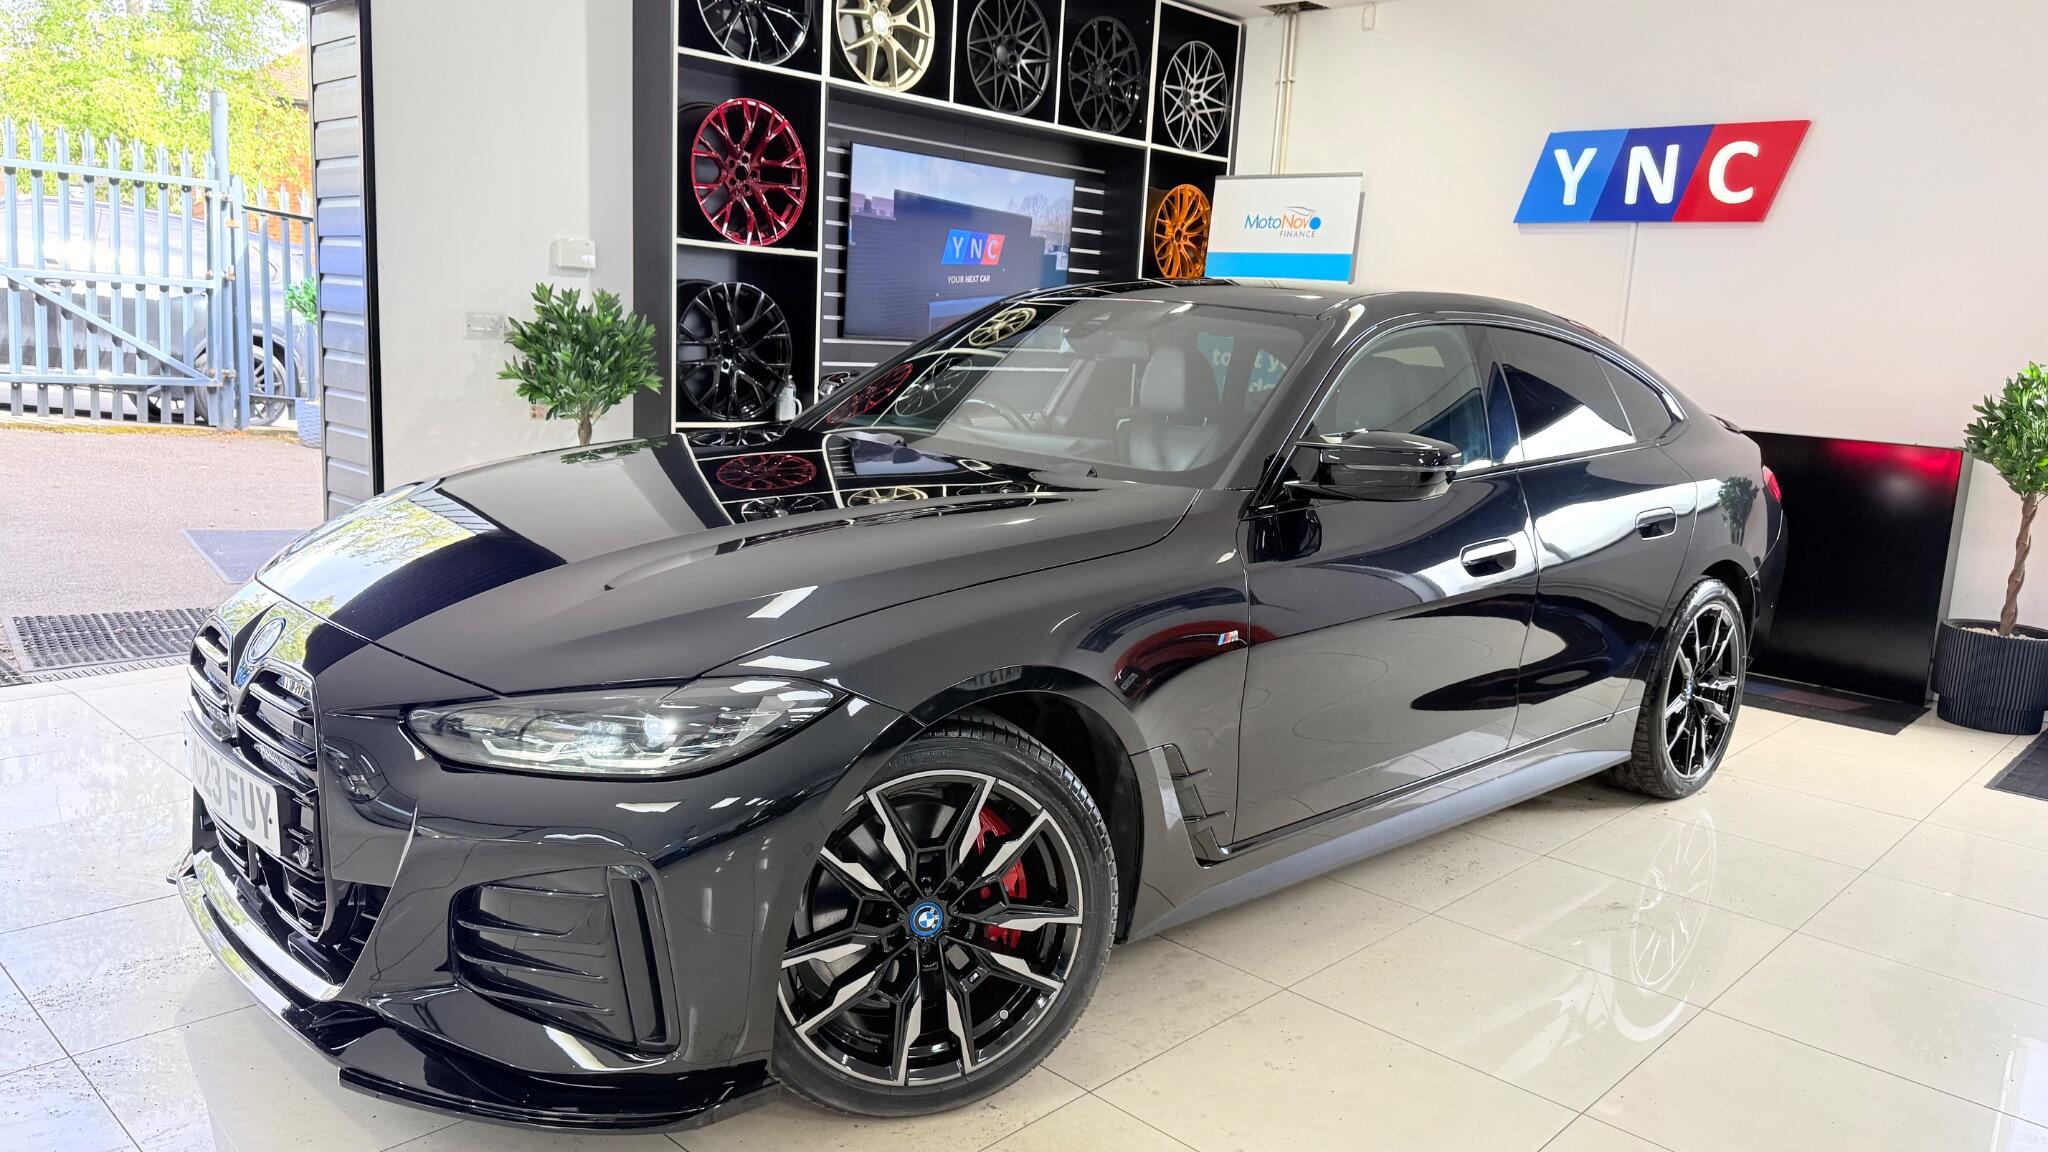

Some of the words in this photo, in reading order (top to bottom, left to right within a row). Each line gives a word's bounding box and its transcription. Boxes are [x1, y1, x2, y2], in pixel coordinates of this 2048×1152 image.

[1553, 141, 1759, 206] YNC
[1279, 230, 1316, 239] FINANCE
[952, 236, 998, 260] YNC
[948, 275, 964, 284] YOUR
[965, 275, 979, 283] NEXT
[980, 274, 991, 283] CAR
[225, 766, 271, 840] FUY
